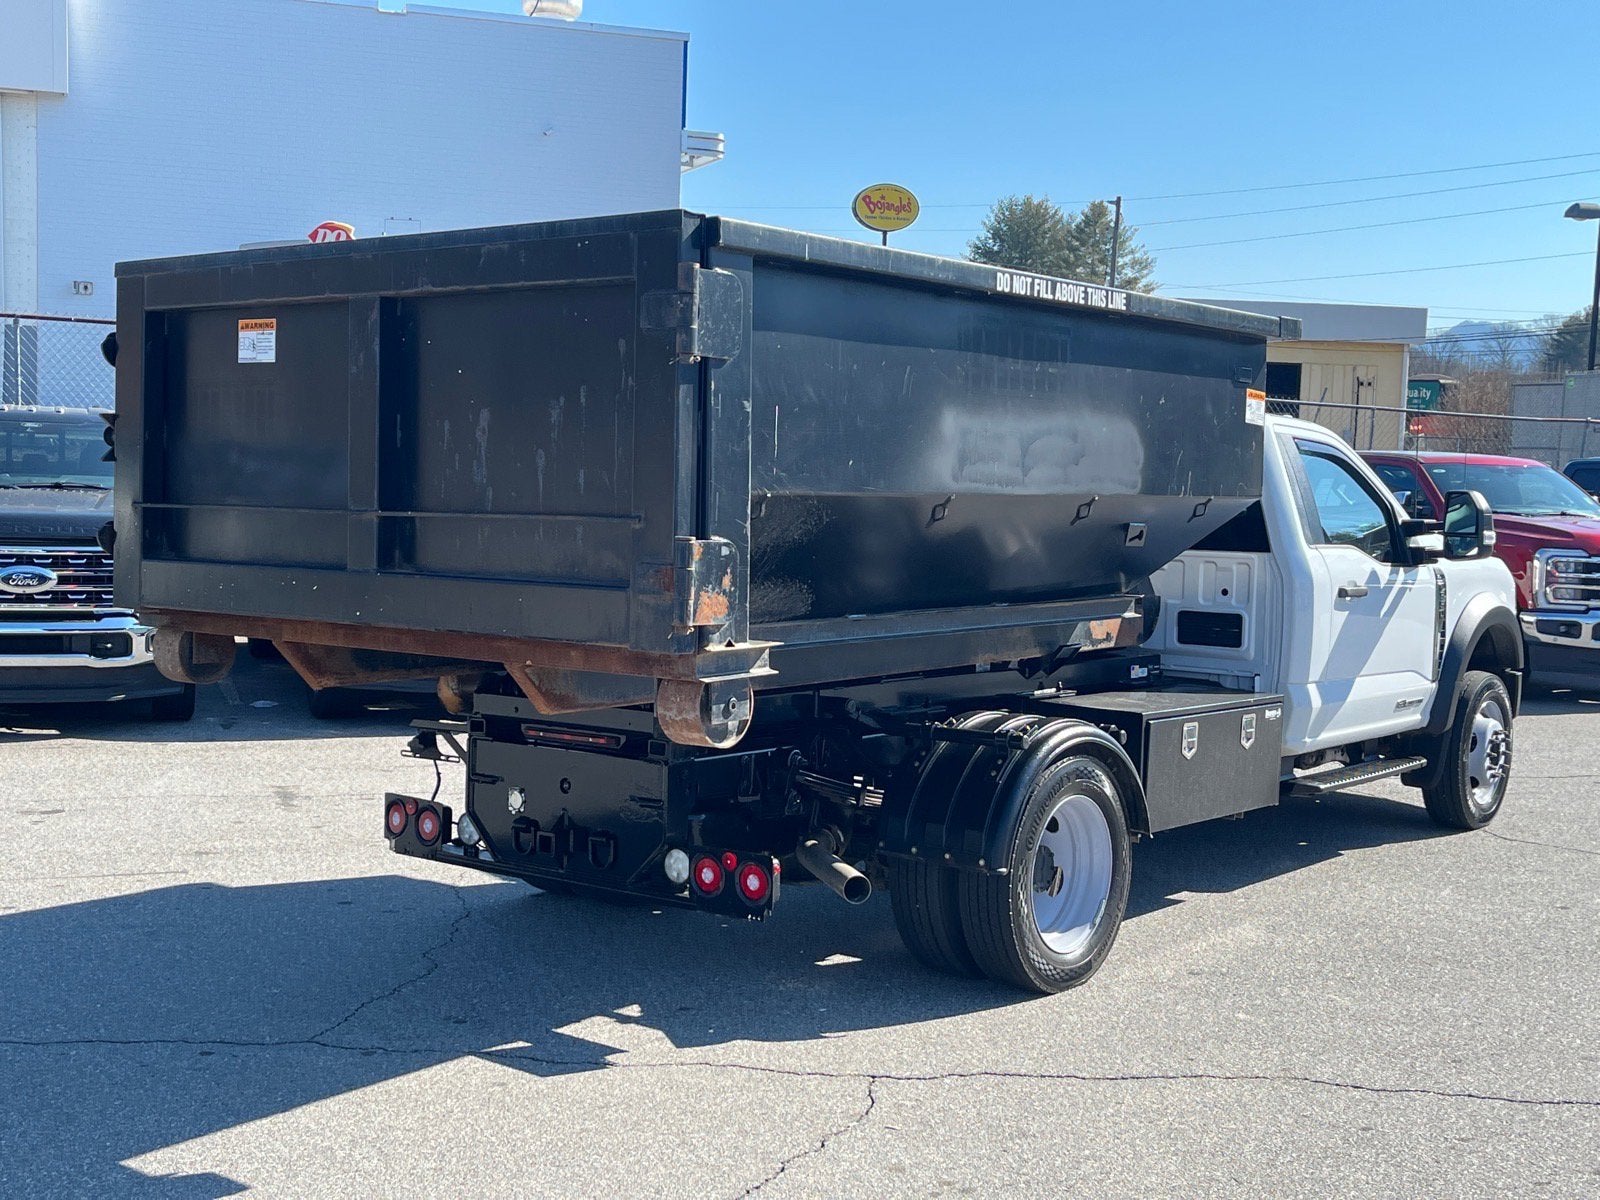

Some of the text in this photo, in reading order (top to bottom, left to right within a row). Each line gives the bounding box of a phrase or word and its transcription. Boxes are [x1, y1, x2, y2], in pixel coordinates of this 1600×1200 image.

[996, 272, 1127, 310] DO NOT FILL ABOVE THIS LINE
[244, 321, 274, 330] WARNING
[1407, 387, 1431, 400] uaity
[9, 573, 39, 586] Ford
